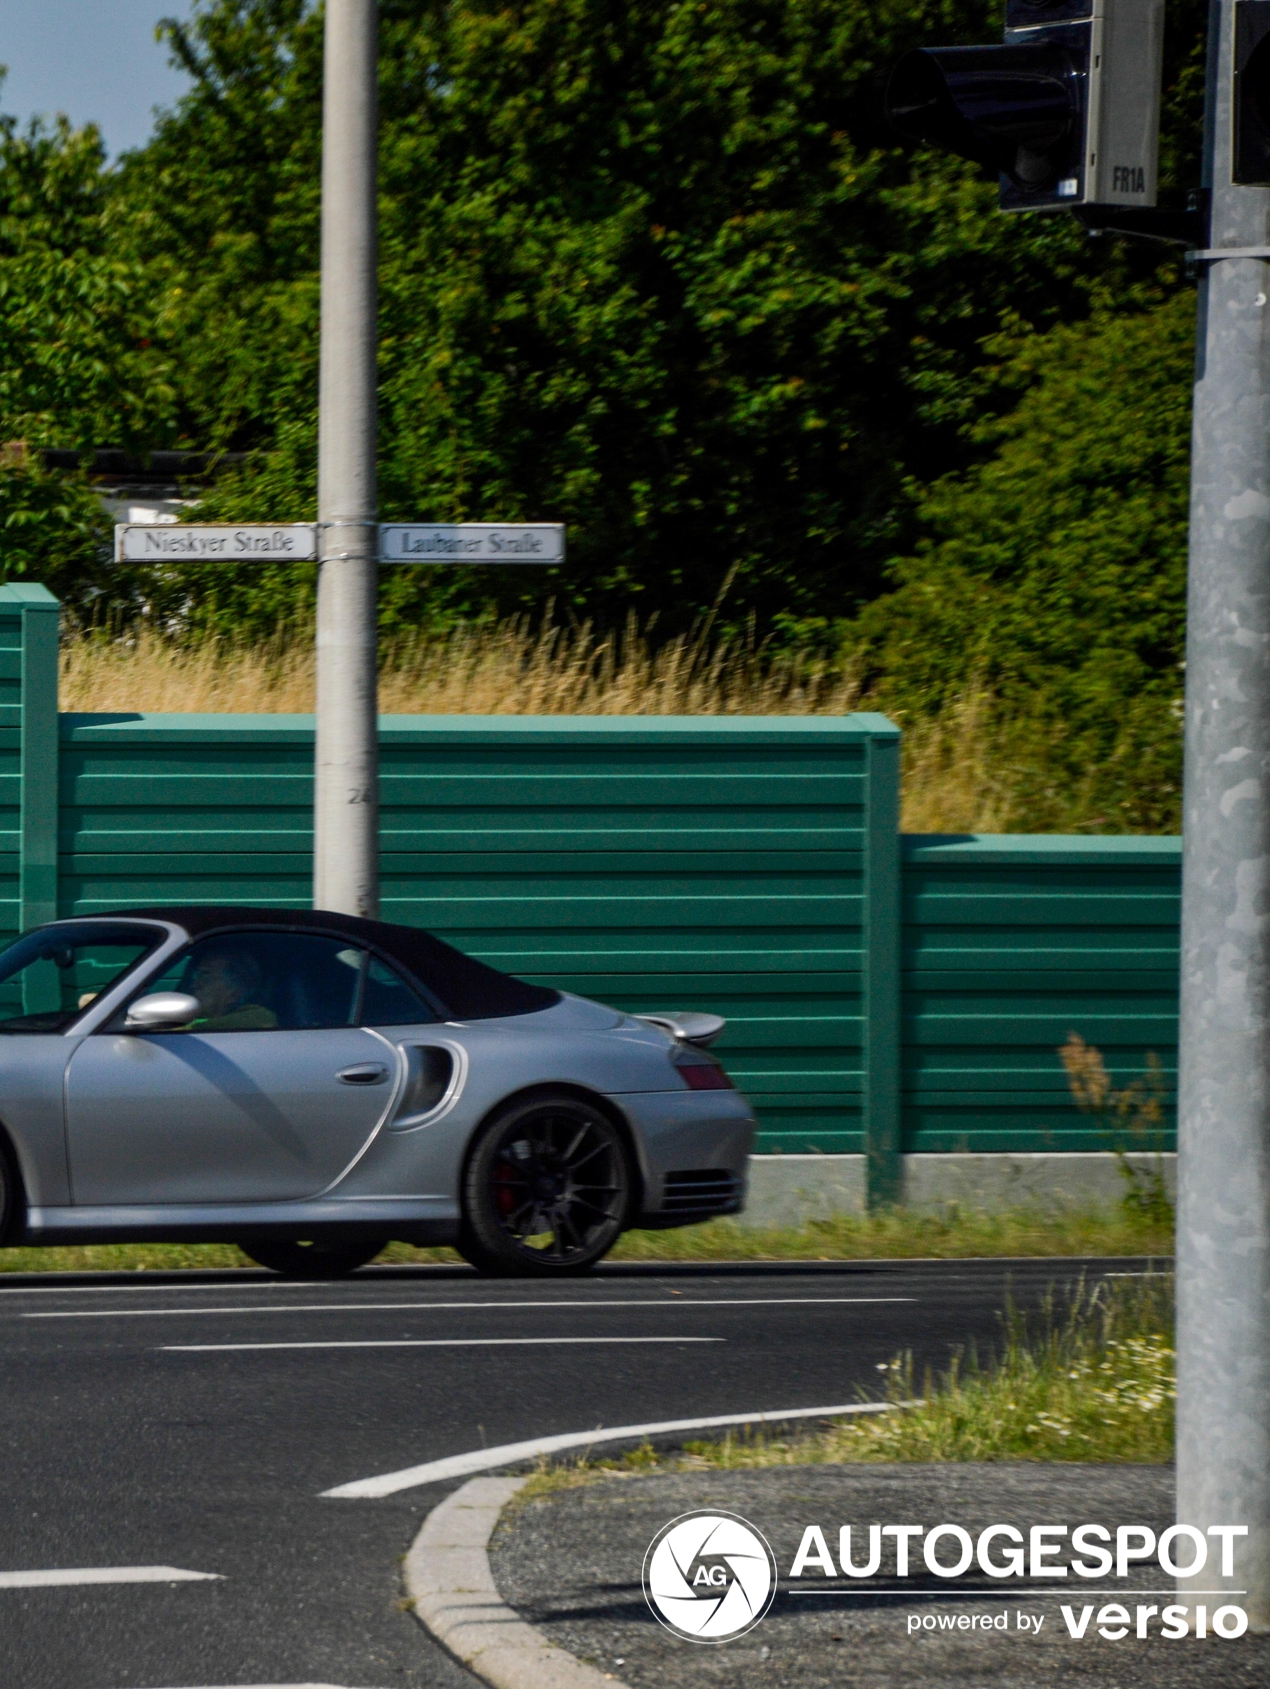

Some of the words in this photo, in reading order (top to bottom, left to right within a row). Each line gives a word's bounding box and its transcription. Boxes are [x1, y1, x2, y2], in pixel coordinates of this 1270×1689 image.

[1113, 166, 1145, 193] FR1A
[144, 531, 228, 555] Nieskyer
[234, 531, 294, 551] Straße
[488, 532, 543, 553] Straße
